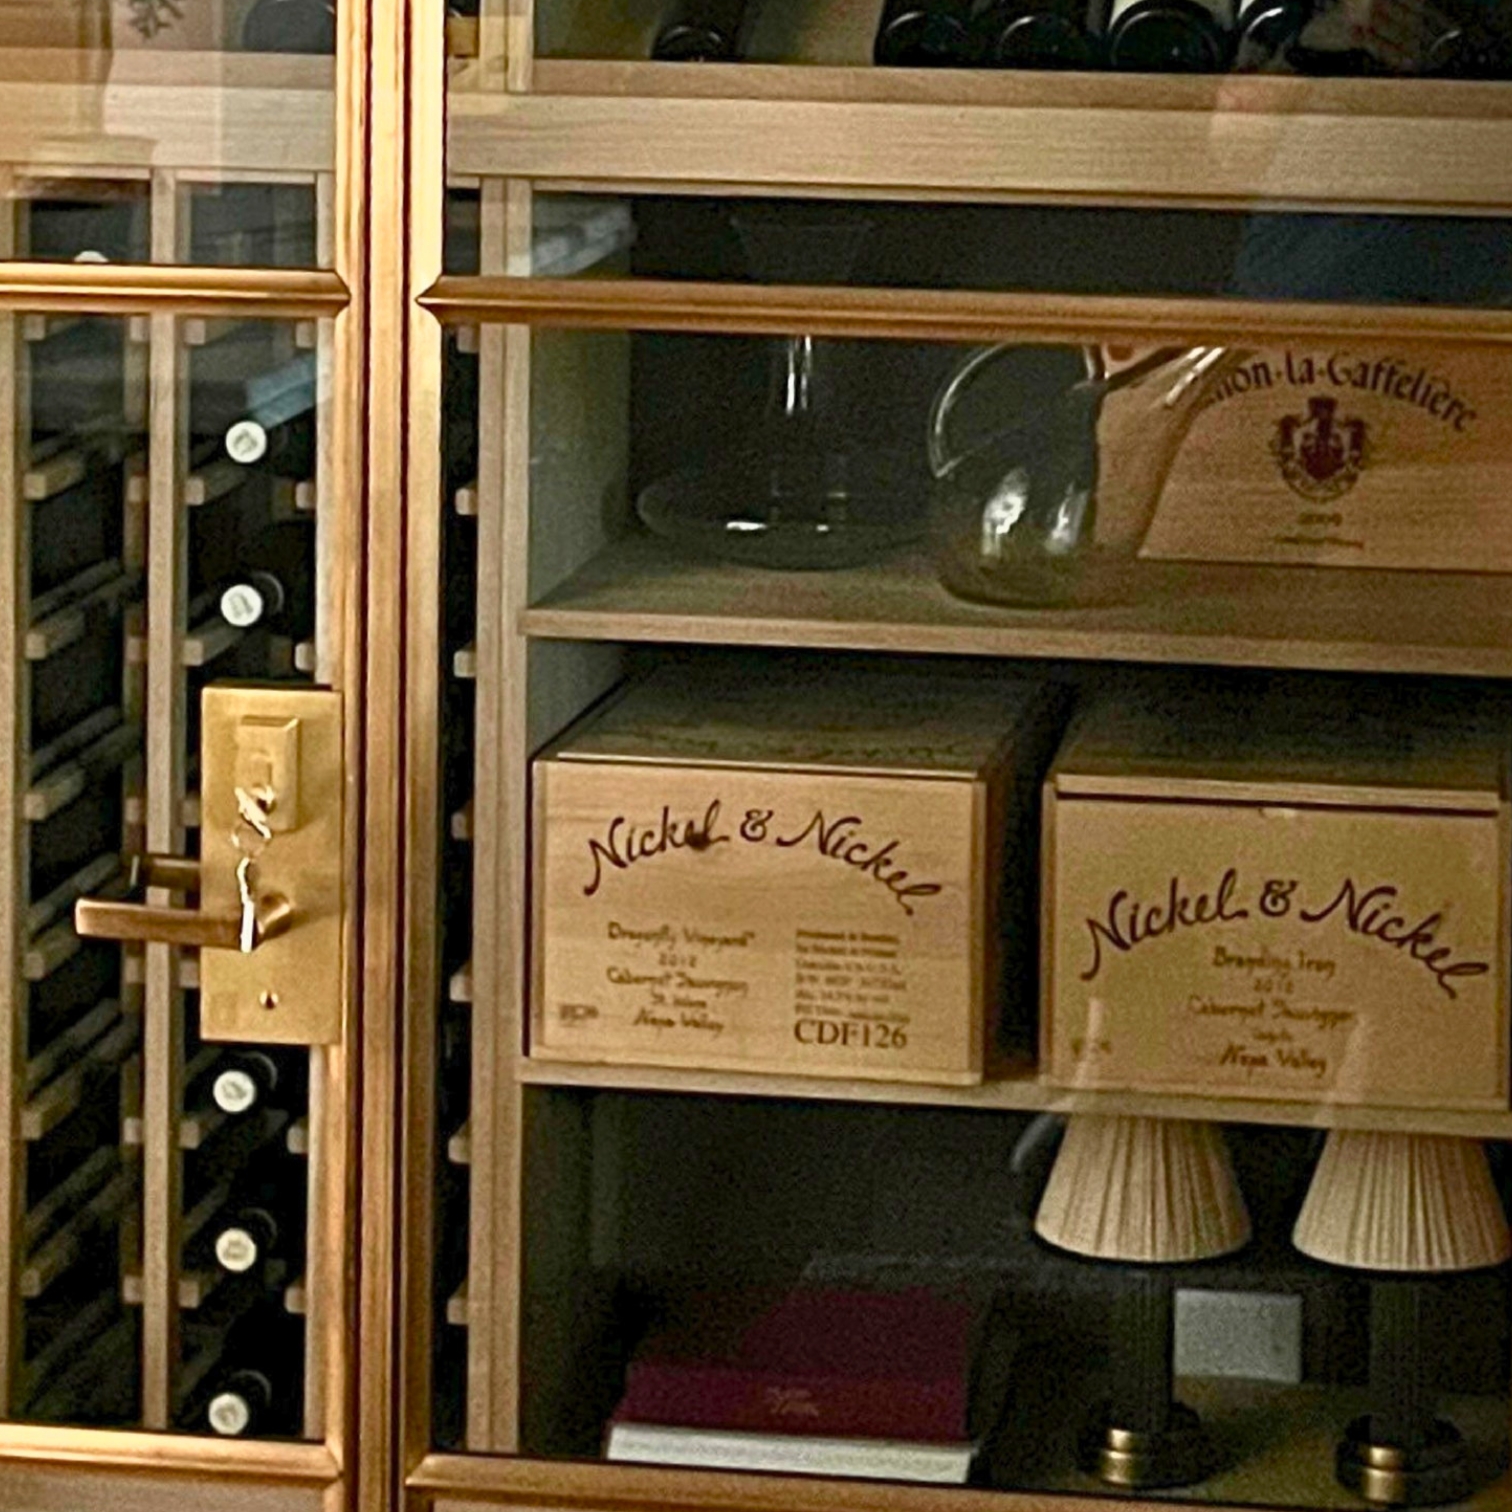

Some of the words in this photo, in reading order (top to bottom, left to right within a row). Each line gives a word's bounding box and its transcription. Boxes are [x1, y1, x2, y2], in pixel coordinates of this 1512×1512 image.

[584, 798, 730, 896] Nickel
[740, 809, 774, 843] &
[775, 810, 942, 916] Nickel
[1081, 868, 1248, 982] Nickel
[1259, 879, 1297, 917] &
[1300, 878, 1489, 1000] Nickel
[794, 1018, 908, 1049] CDF126
